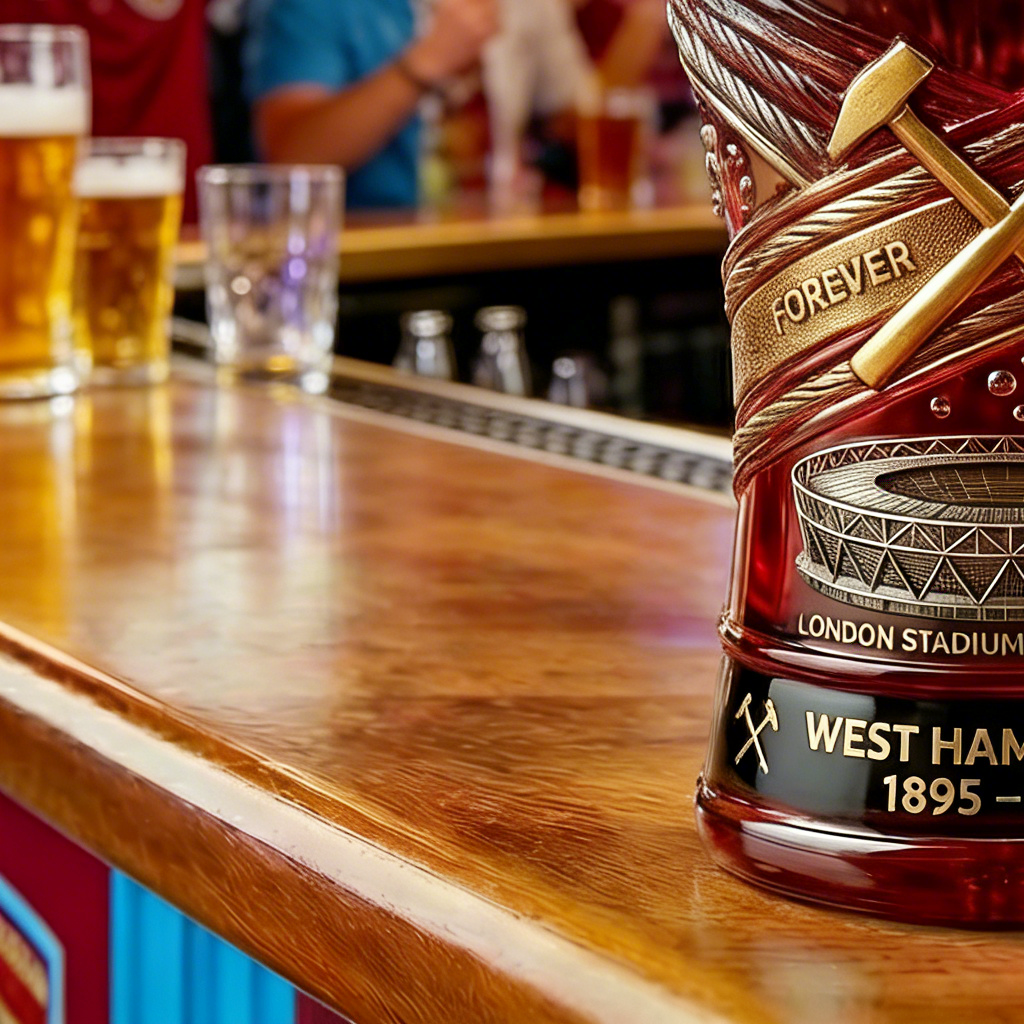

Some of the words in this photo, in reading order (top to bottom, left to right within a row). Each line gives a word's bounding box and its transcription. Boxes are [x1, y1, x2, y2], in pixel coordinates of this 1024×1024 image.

[771, 241, 917, 336] FOREVER
[798, 612, 895, 650] LONDON
[901, 627, 1024, 656] STADIUM
[805, 710, 919, 763] WEST
[882, 774, 982, 816] 1895
